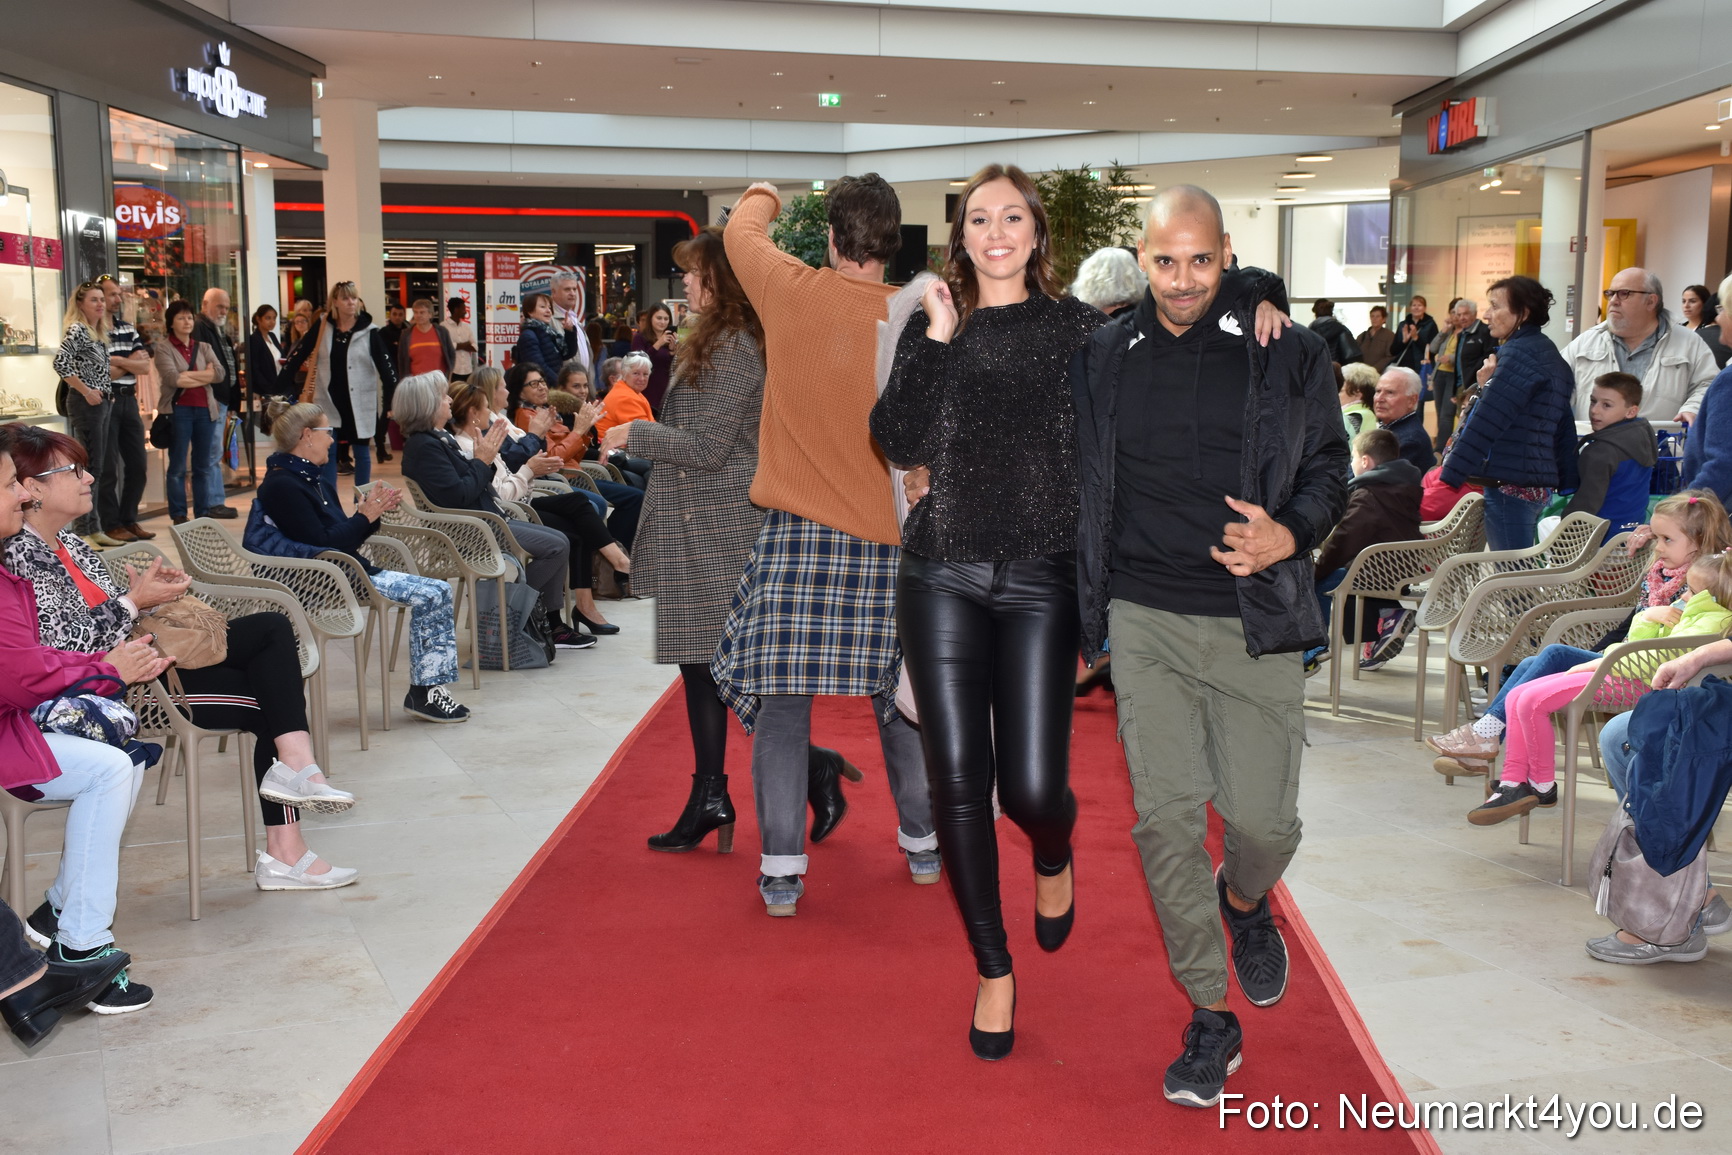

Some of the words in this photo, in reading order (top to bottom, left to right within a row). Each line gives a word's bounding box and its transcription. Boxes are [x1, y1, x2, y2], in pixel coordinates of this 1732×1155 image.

[1427, 97, 1478, 155] WÖHRL
[114, 200, 181, 230] ervis
[499, 291, 516, 304] dm
[494, 324, 520, 335] REWE
[494, 335, 520, 343] CENTER
